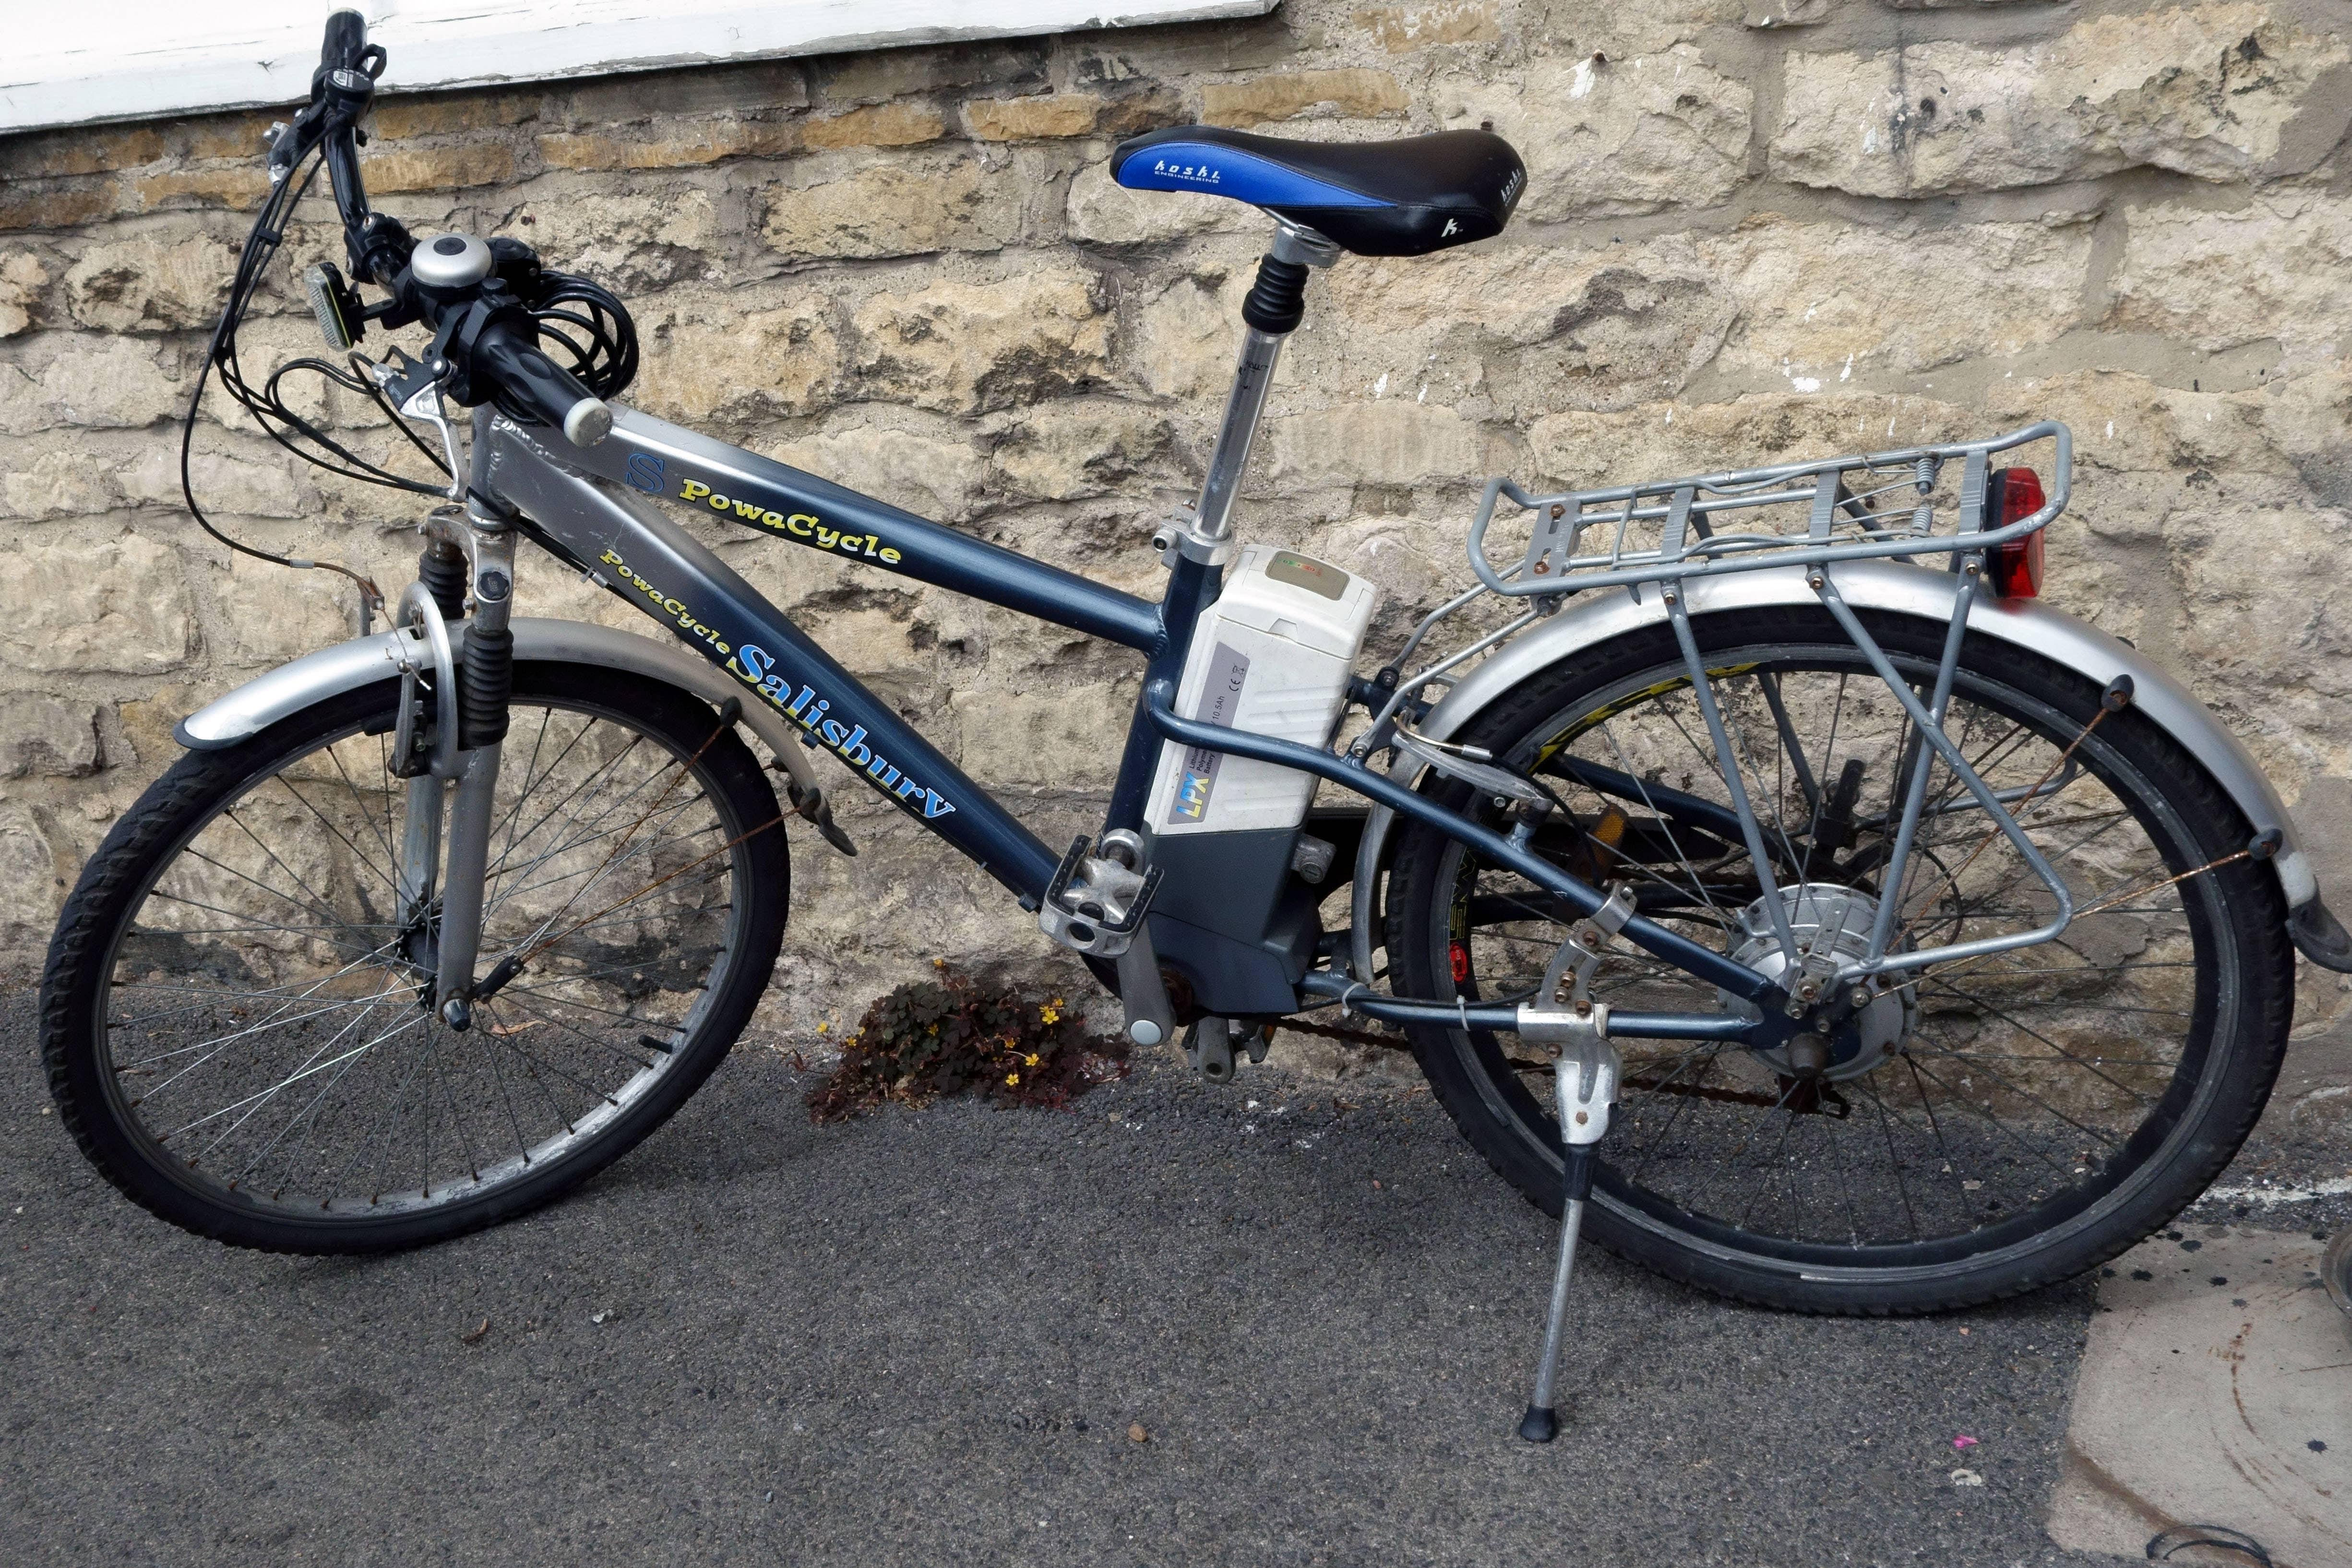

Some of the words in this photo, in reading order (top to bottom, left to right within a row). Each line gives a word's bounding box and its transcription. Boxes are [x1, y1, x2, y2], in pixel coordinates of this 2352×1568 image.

[1155, 171, 1219, 183] ENGINEERING
[626, 453, 665, 493] S
[678, 478, 901, 565] PowaCycle
[599, 549, 731, 656] PowaCycle
[1212, 696, 1225, 719] 10.5Ah
[726, 644, 956, 818] Salisbury
[1189, 748, 1199, 768] Lithium
[1197, 749, 1207, 771] Polyme
[1204, 754, 1215, 774] Battery
[1176, 771, 1209, 818] LPX
